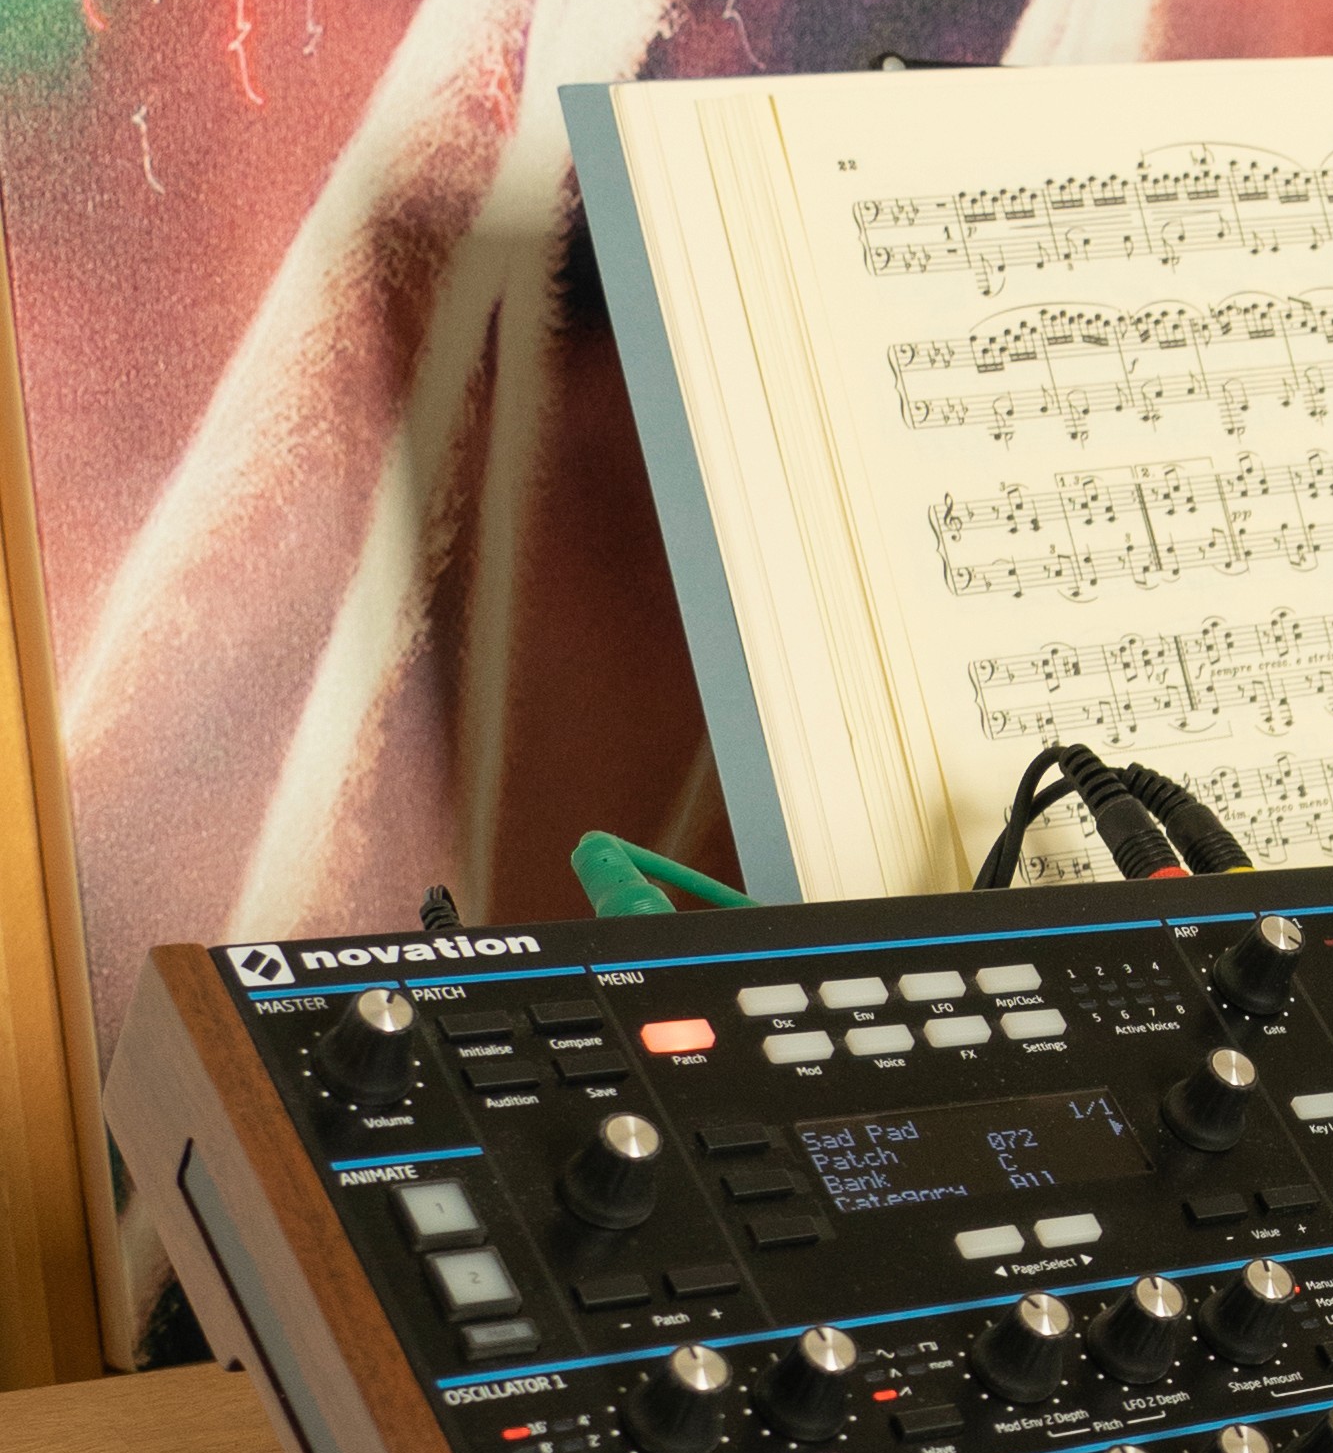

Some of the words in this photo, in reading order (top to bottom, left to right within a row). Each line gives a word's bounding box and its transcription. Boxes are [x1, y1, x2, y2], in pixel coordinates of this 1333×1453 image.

[1173, 925, 1199, 939] ARP
[300, 933, 540, 969] novation
[596, 971, 645, 986] MENU
[411, 985, 467, 1002] PATCH
[255, 993, 329, 1015] MASTER
[931, 1002, 955, 1014] LFO
[995, 994, 1045, 1009] Arp/Clock
[852, 1010, 875, 1022] Env
[772, 1018, 796, 1029] Osc
[1114, 1024, 1147, 1035] Active
[1145, 1021, 1181, 1032] Voices
[1262, 1025, 1287, 1036] Gate
[548, 1036, 603, 1050] Compare
[1022, 1041, 1068, 1054] Settings
[458, 1044, 513, 1058] Initialise
[959, 1049, 978, 1060] FX
[671, 1053, 707, 1065] Patch
[873, 1057, 906, 1069] Voice
[795, 1065, 823, 1077] Mod
[585, 1087, 618, 1099] Save
[485, 1095, 540, 1109] Audition
[1068, 1096, 1113, 1121] 1/1
[362, 1115, 414, 1129] Volume
[801, 1127, 855, 1152] Sad
[864, 1120, 920, 1144] Pad
[1308, 1124, 1329, 1135] Key
[985, 1128, 1039, 1151] 072
[812, 1146, 899, 1173] Patch
[340, 1164, 419, 1186] ANIMATE
[822, 1169, 892, 1195] Bank
[1009, 1169, 1057, 1191] All
[1250, 1228, 1281, 1240] Value
[1010, 1257, 1078, 1276] Page/Select
[651, 1312, 691, 1327] Patch
[1227, 1379, 1261, 1393] Shape
[1262, 1371, 1304, 1387] Amount
[442, 1376, 552, 1406] OSCILLATOR
[551, 1374, 568, 1390] 1
[1122, 1397, 1147, 1412] LFO
[1145, 1396, 1157, 1408] 2
[1155, 1391, 1191, 1406] Depth
[994, 1420, 1022, 1434] Mod
[1020, 1417, 1044, 1430] Env
[1043, 1414, 1055, 1426] 2
[1052, 1409, 1090, 1424] Depth
[1092, 1418, 1124, 1432] Pitch
